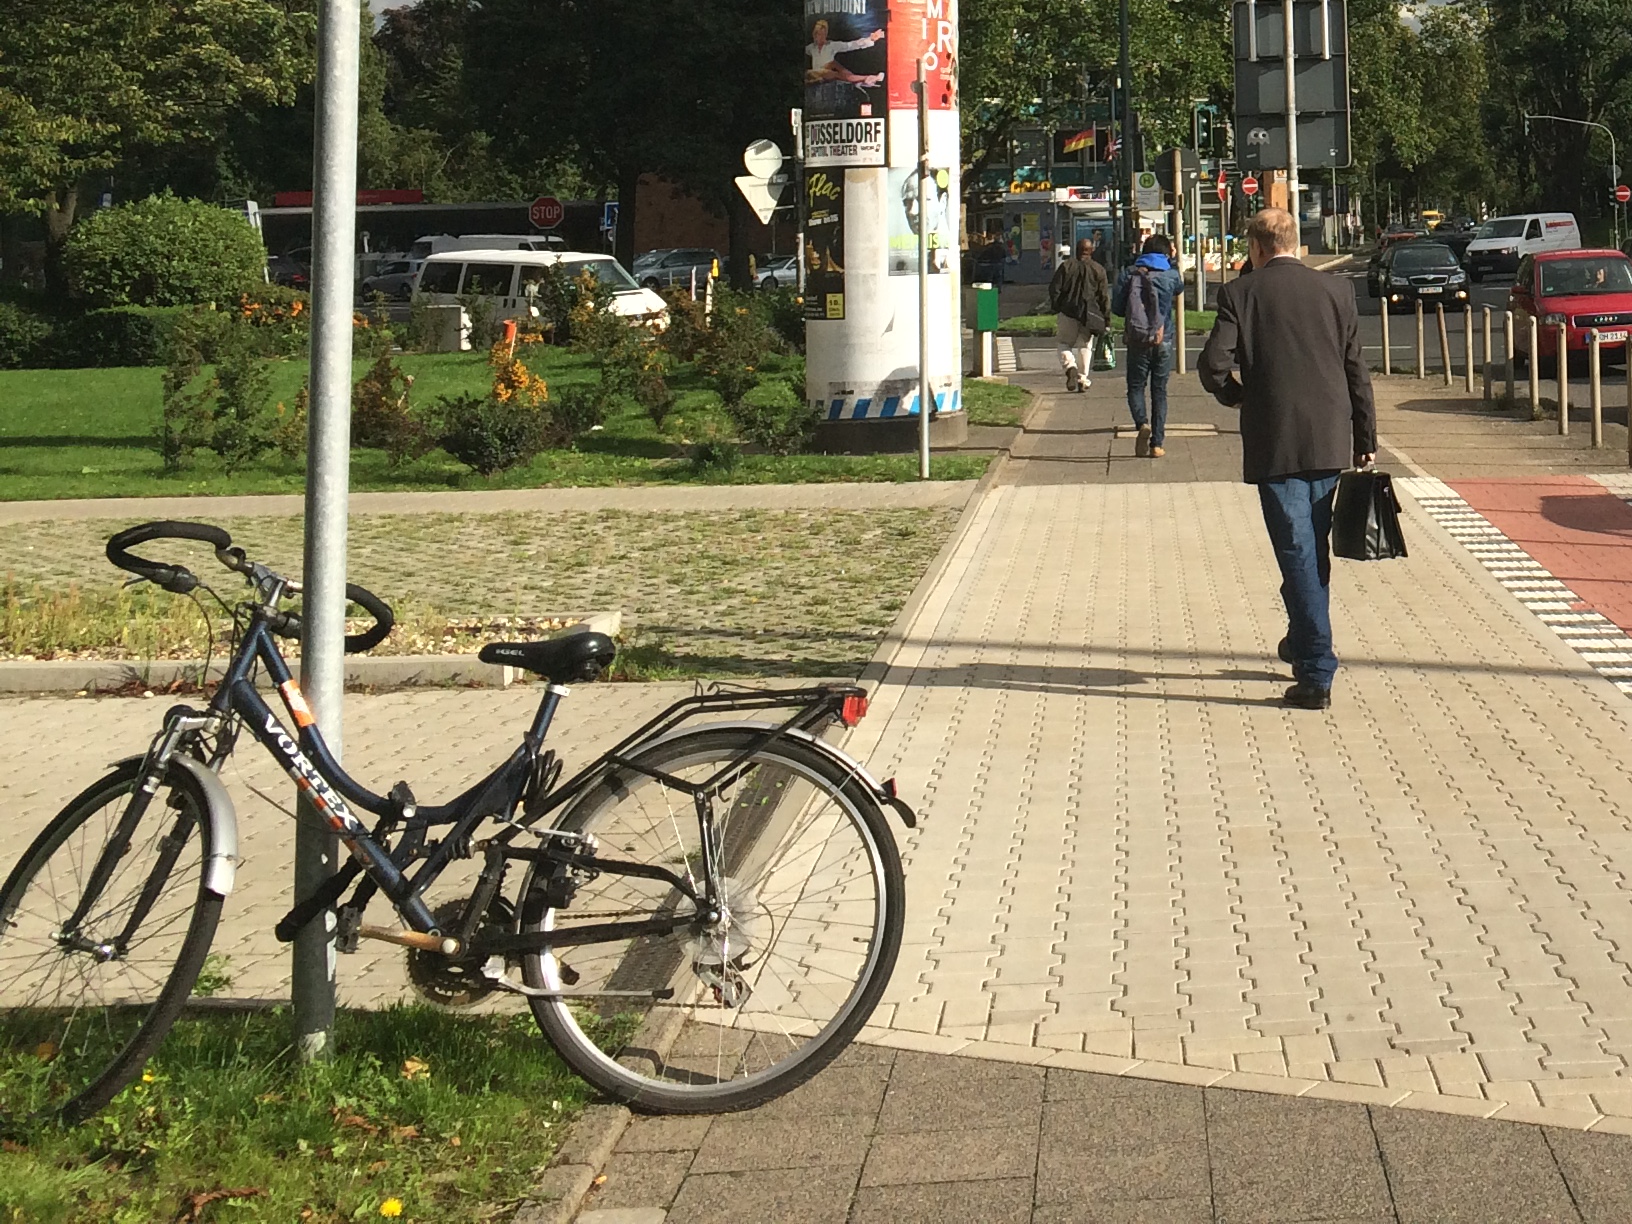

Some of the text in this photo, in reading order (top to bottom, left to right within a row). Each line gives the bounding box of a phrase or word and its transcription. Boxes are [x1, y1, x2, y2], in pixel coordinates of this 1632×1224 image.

[829, 144, 858, 156] THEATER
[532, 205, 561, 220] STOP
[264, 712, 360, 831] VORTEX
